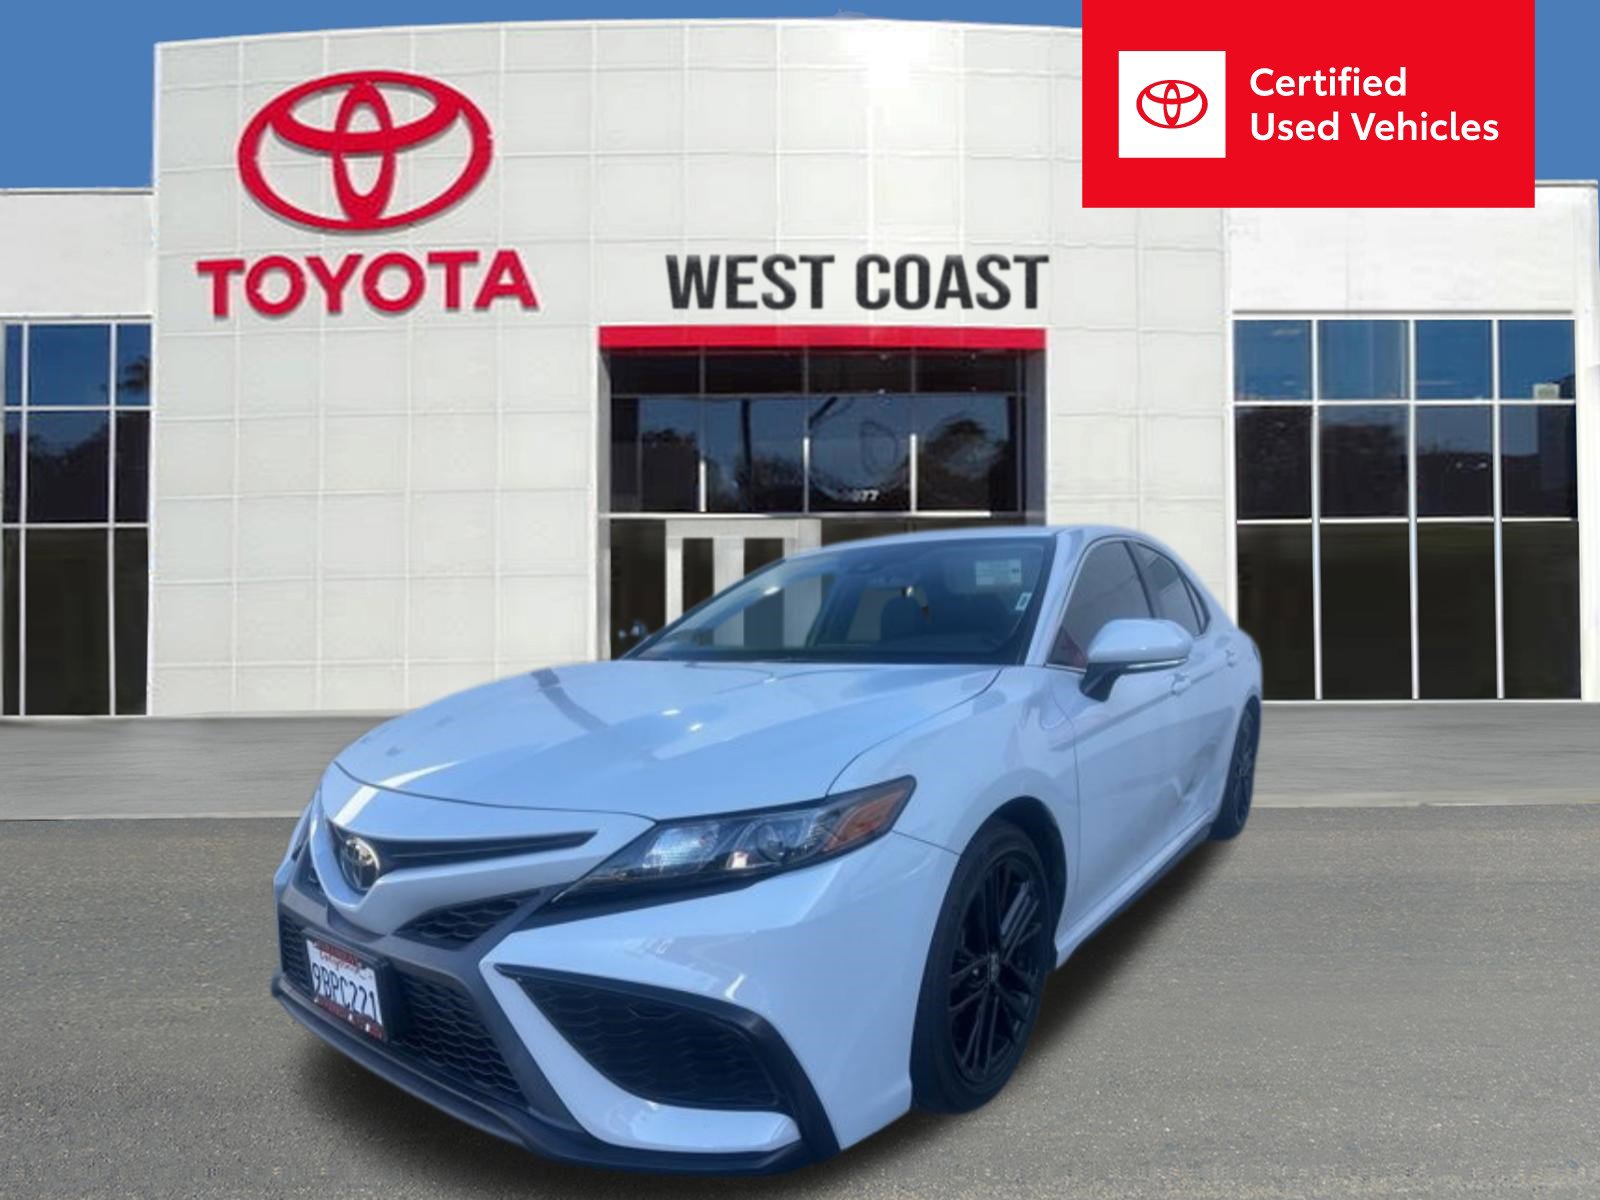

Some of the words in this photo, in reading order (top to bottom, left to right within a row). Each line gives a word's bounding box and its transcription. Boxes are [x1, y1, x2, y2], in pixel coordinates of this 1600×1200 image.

[196, 248, 538, 318] TOYOTA
[666, 254, 835, 310] WEST
[856, 254, 1049, 310] COAST
